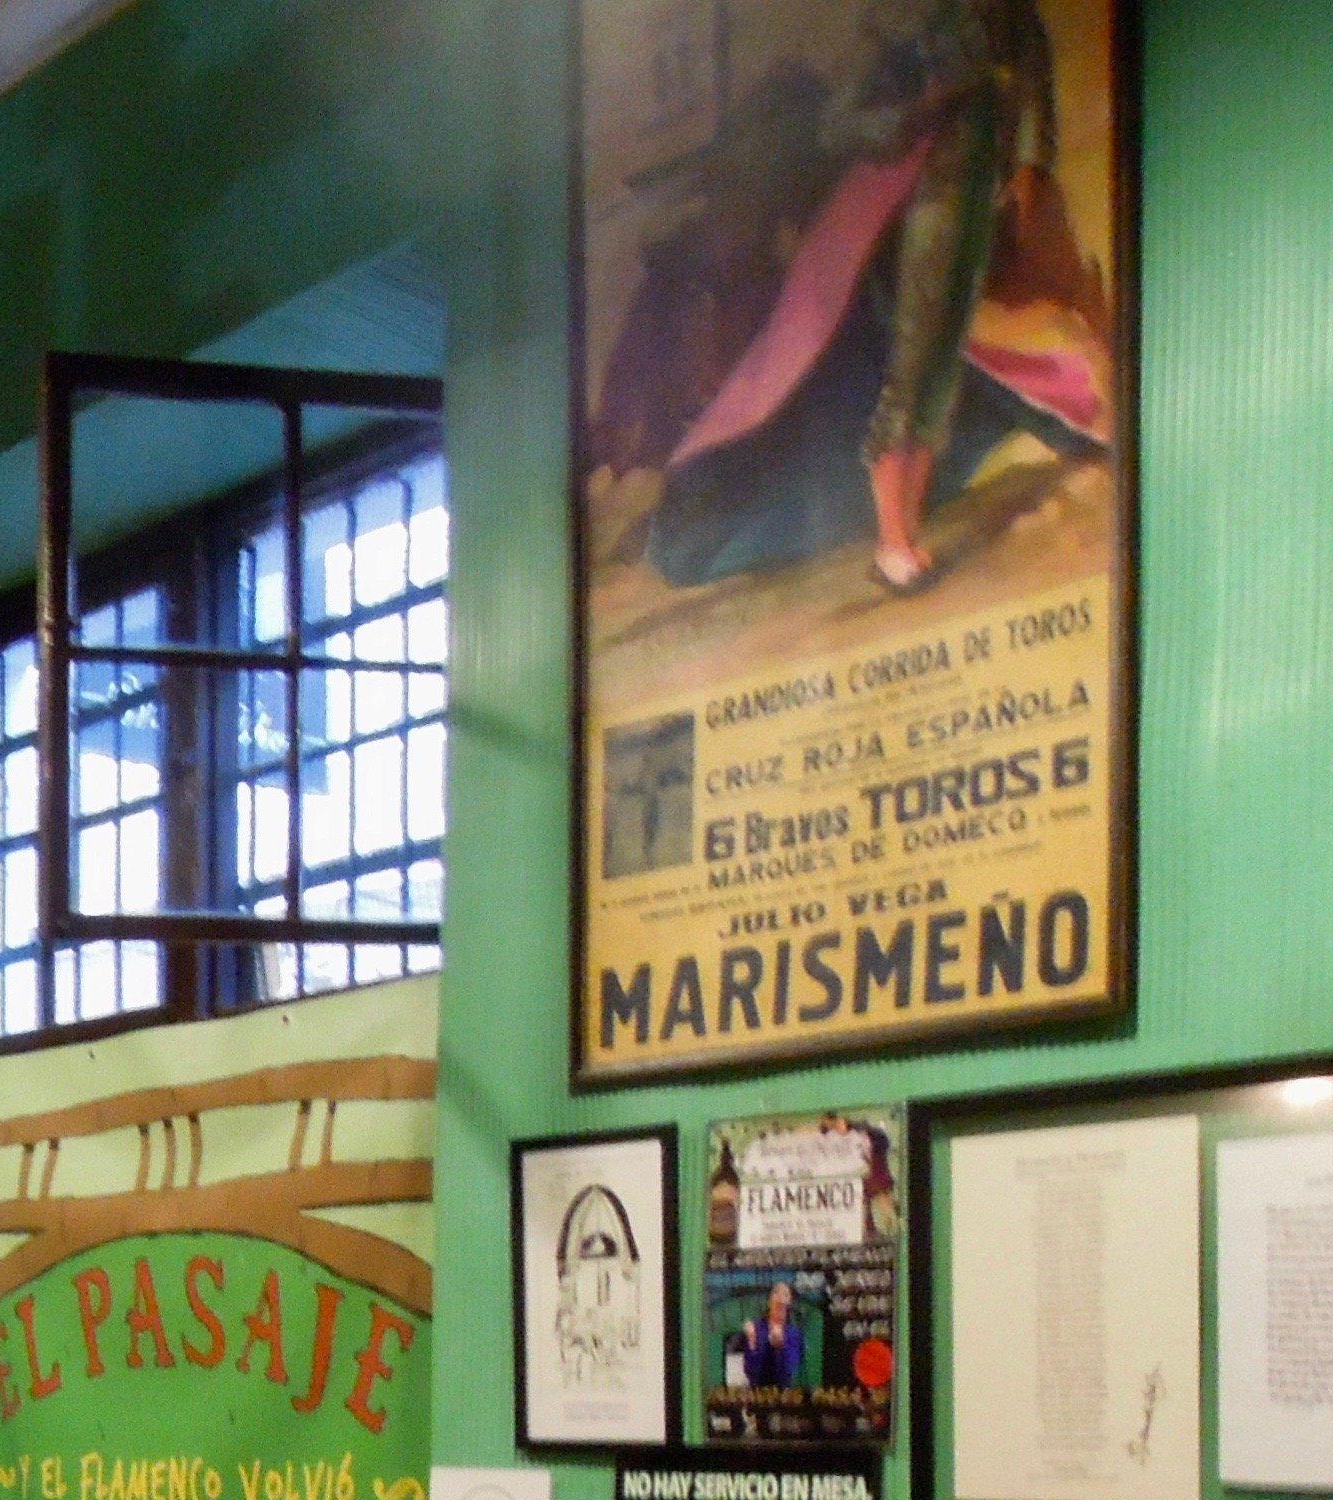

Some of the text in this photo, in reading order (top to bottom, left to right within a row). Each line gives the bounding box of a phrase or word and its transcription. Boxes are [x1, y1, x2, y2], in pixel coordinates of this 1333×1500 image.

[704, 672, 836, 732] GRANDIOSA
[847, 640, 951, 695] CORRIDA
[963, 626, 991, 663] DE
[1006, 597, 1092, 651] TOROS
[705, 752, 786, 796] CRUZ
[801, 730, 886, 773] ROJA
[905, 678, 1090, 749] ESPAÑOLA
[704, 816, 735, 863] 6
[744, 803, 850, 851] Bravos
[860, 749, 1040, 830] TOROS
[1052, 736, 1090, 789] 6
[707, 849, 836, 889] MARQUES
[852, 833, 885, 864] DE
[719, 901, 826, 940] JULIO
[848, 878, 948, 917] VEGA
[598, 888, 1091, 1050] MARISMEÑO
[746, 1182, 856, 1214] FLAMENCO
[74, 1255, 416, 1435] PASAJE
[42, 1456, 66, 1500] EL
[623, 1470, 651, 1500] NO
